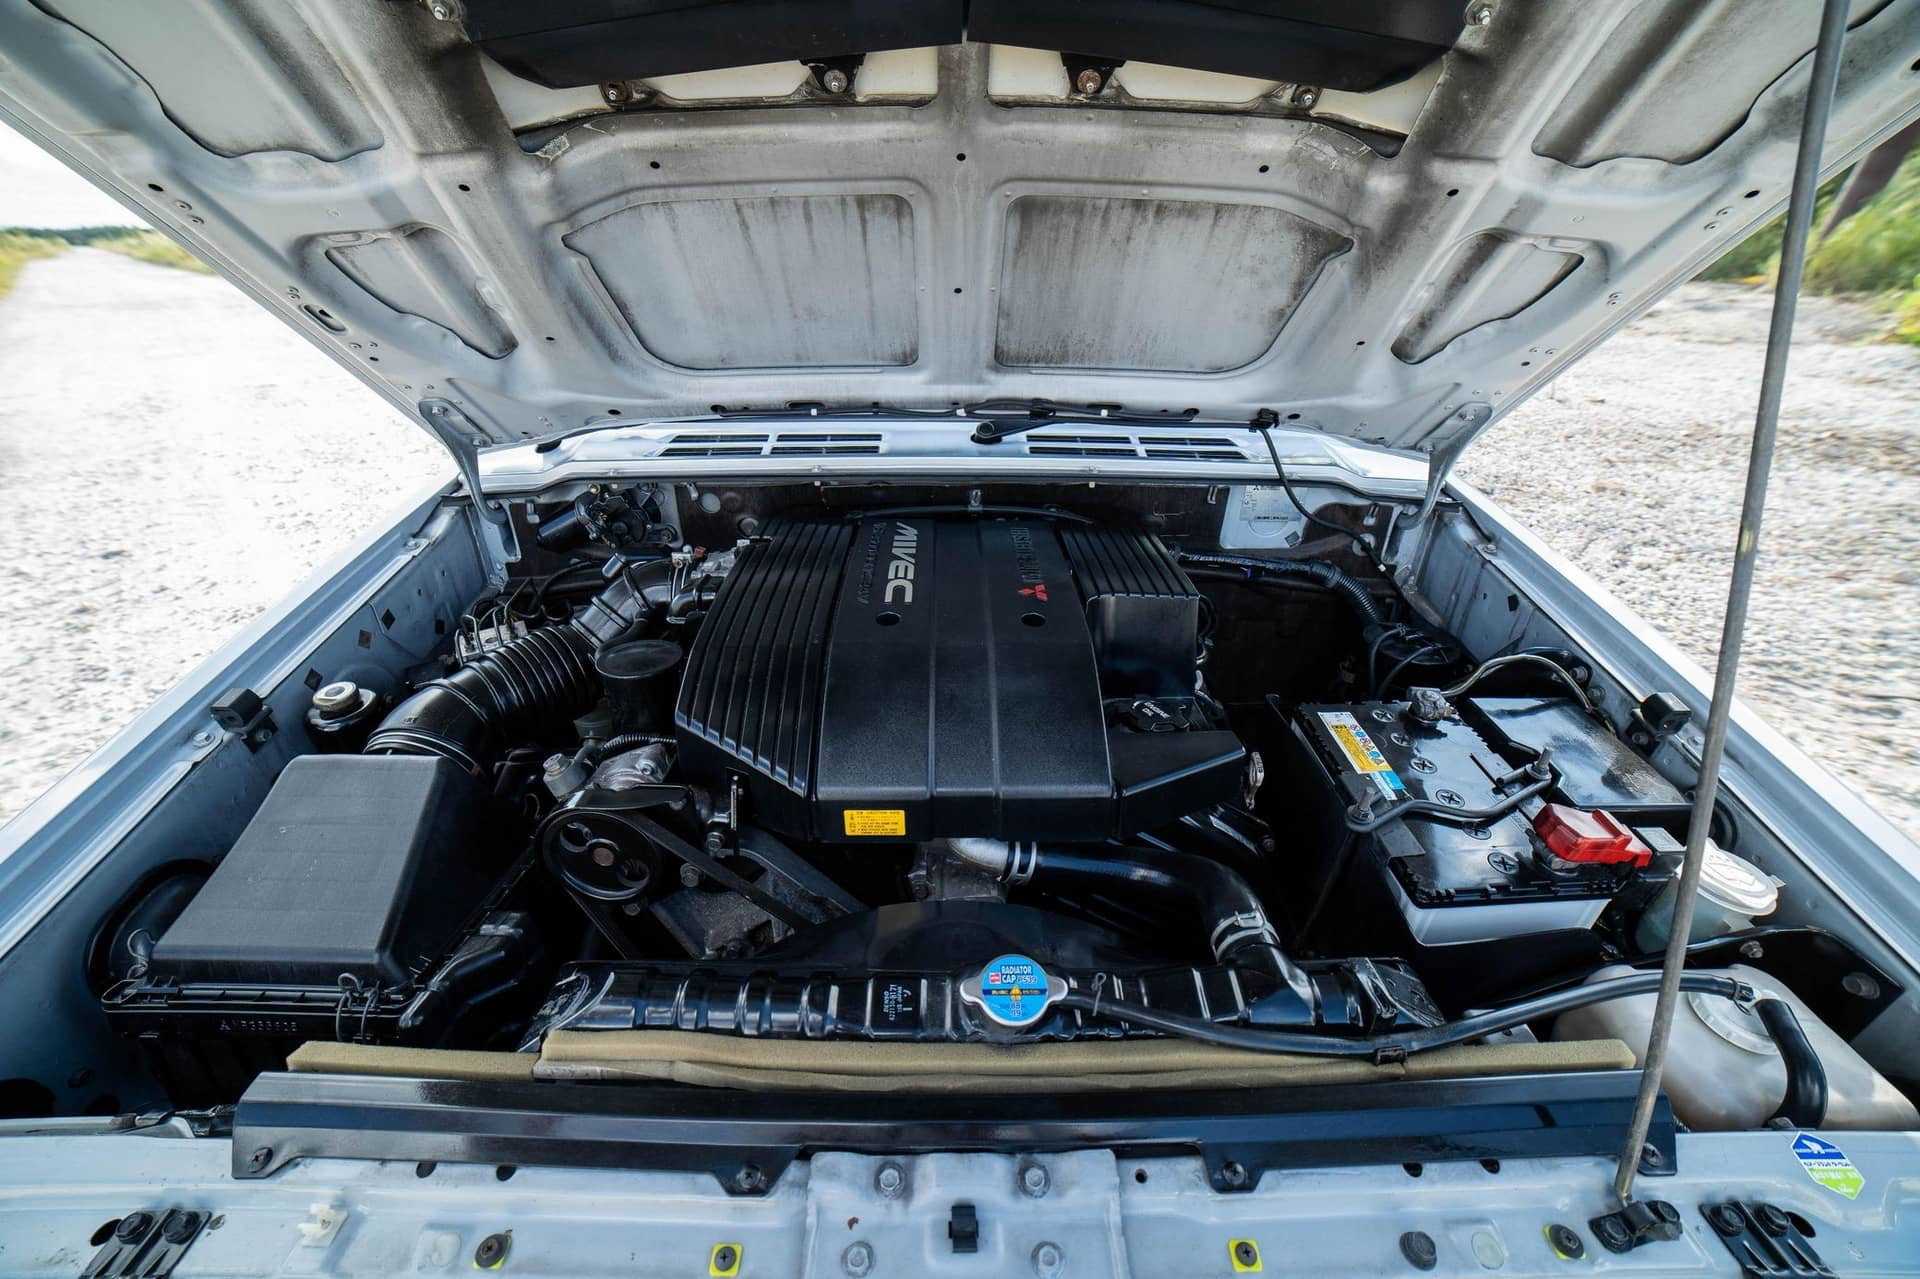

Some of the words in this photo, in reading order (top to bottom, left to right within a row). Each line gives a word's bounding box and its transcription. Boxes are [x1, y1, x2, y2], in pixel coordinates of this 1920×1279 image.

[884, 522, 919, 603] MIVEC
[1001, 965, 1032, 974] RADIATOR
[1001, 974, 1017, 983] CAP
